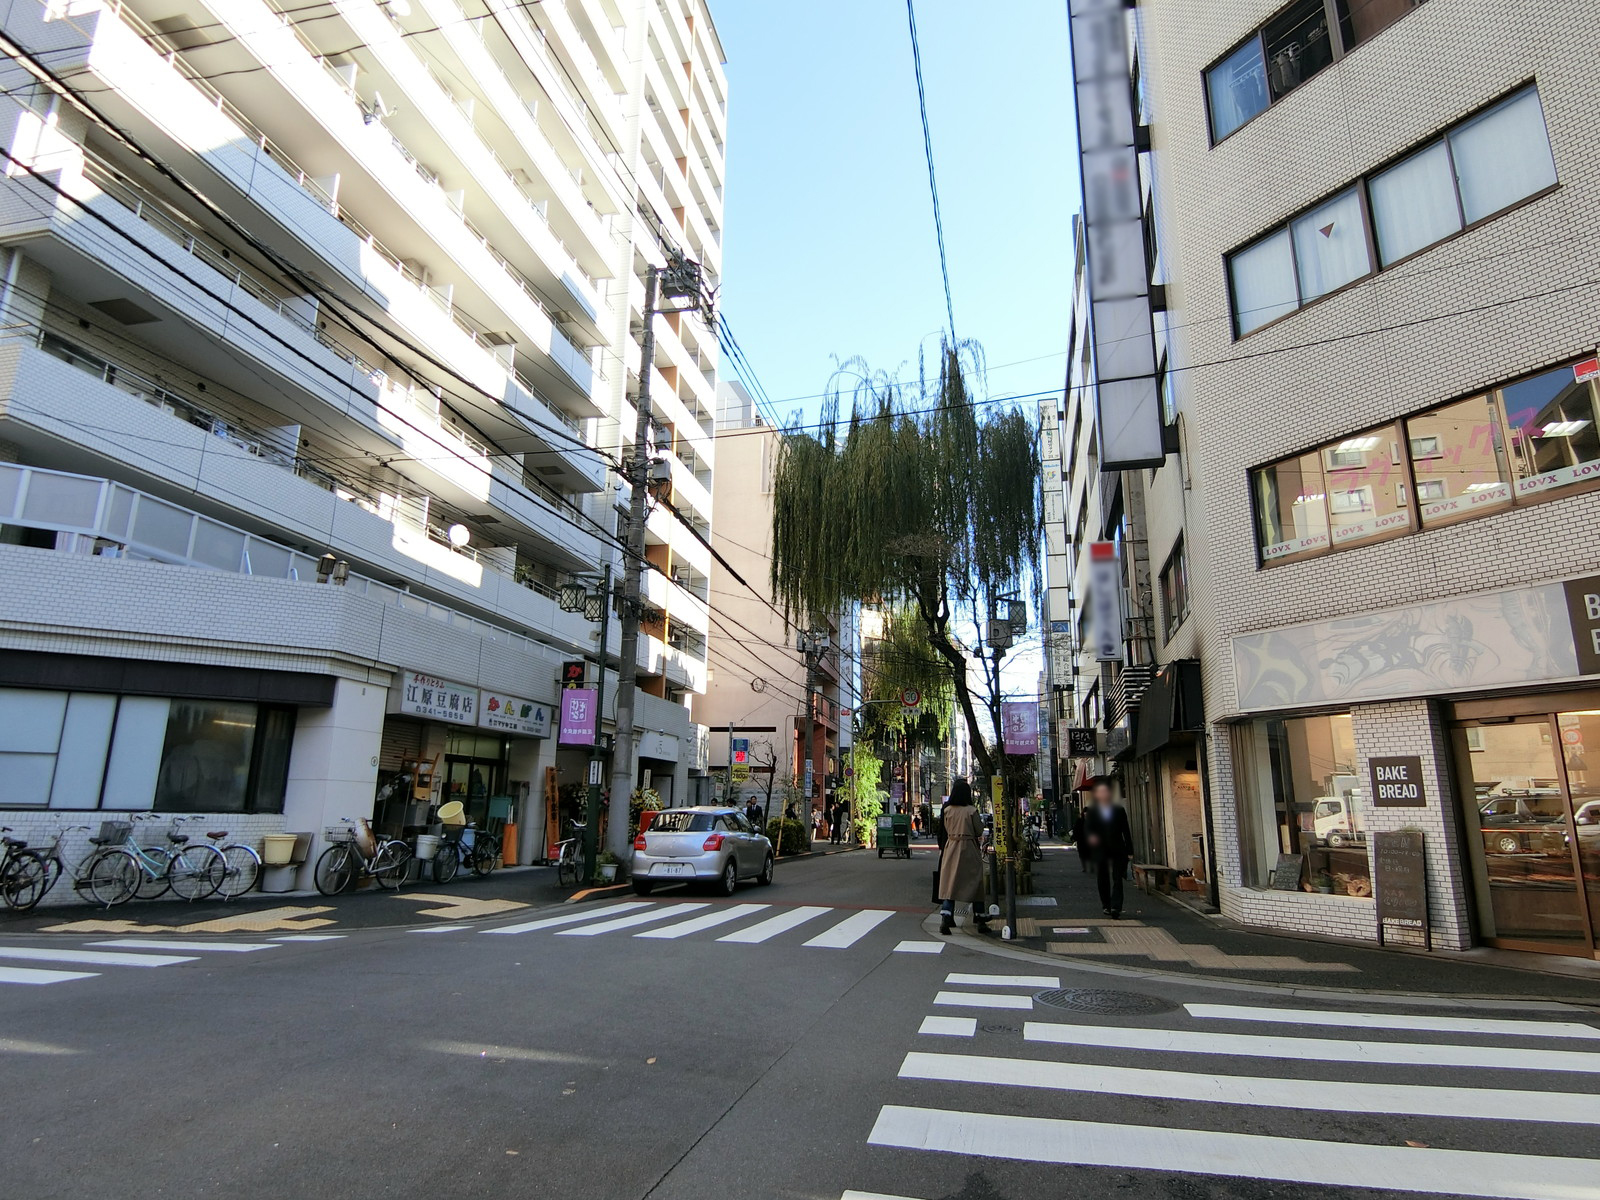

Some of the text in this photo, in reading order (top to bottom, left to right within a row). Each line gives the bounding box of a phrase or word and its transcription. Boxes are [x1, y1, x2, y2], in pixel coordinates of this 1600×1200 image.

[1266, 543, 1291, 556] LOVX
[1300, 534, 1327, 547] LOVX
[1336, 524, 1364, 538] LOVX
[1375, 513, 1405, 527] LOVX
[1425, 500, 1459, 515] LOVX
[1471, 487, 1507, 503] LOVX
[1519, 474, 1558, 491] LOVX
[407, 684, 473, 713] 江原豆腐店
[906, 692, 917, 701] 30
[1376, 766, 1408, 780] BAKE
[1378, 784, 1418, 798] BREAD
[1383, 917, 1422, 926] BAKE BREAD
